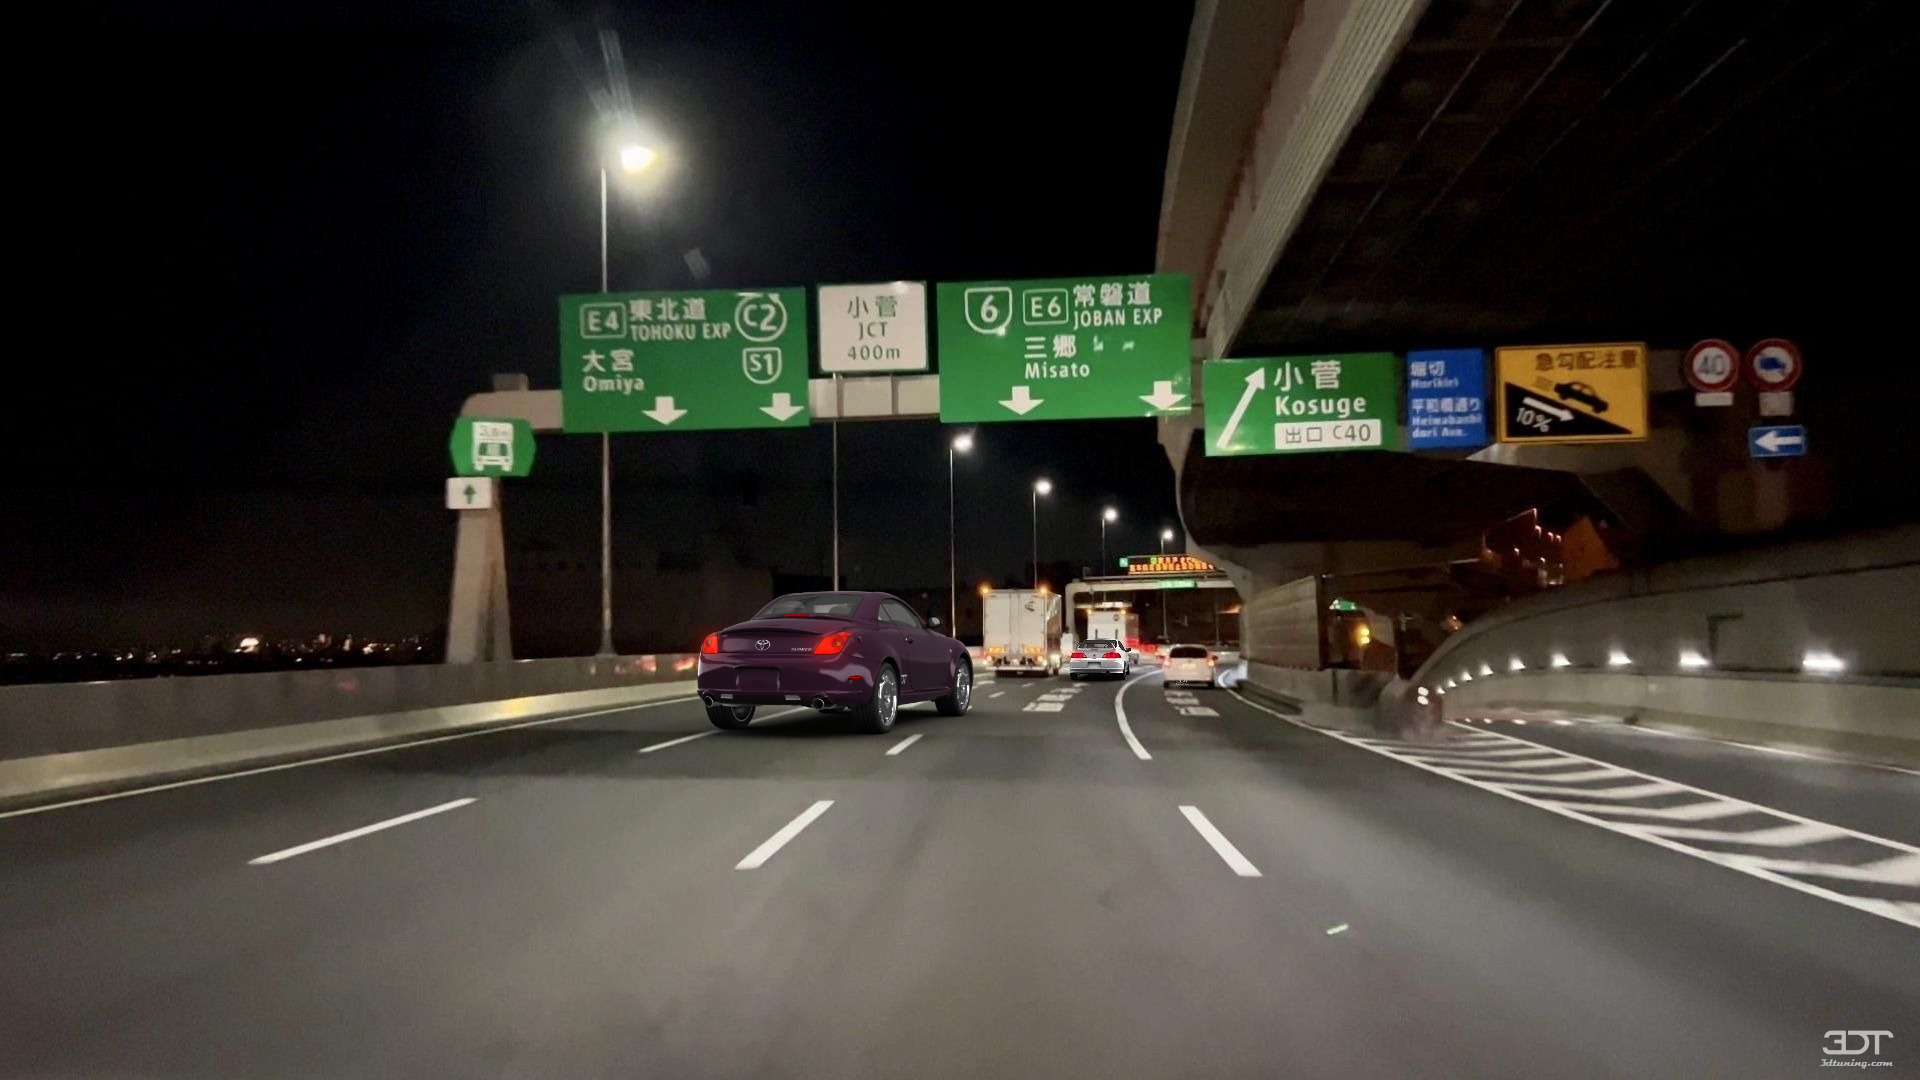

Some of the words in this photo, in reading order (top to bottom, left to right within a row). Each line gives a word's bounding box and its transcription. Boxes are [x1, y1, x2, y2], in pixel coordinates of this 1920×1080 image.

[1073, 281, 1151, 307] 常磐道
[630, 297, 707, 322] 東北道
[742, 303, 778, 332] C2
[847, 295, 898, 319] 小菅
[981, 295, 998, 321] 6
[1031, 295, 1060, 318] E6
[587, 310, 619, 332] E4
[1073, 308, 1126, 330] JOBAN
[1133, 307, 1162, 326] EXP
[630, 323, 697, 342] TOHOKU
[702, 322, 732, 340] EXP
[858, 321, 888, 340] JCT
[847, 345, 901, 361] 400m
[1024, 334, 1078, 360] 三郷
[582, 348, 635, 372] 大宮
[749, 353, 773, 375] S1
[1024, 362, 1090, 379] Misato
[1535, 350, 1639, 371] 急勾配注意
[1697, 354, 1726, 375] 40
[583, 373, 645, 395] Omiya
[1274, 360, 1342, 392] 小菅
[1274, 395, 1367, 418] Kosuge
[1516, 407, 1553, 433] 10%
[1285, 425, 1323, 443] 出口
[1332, 423, 1371, 443] C40
